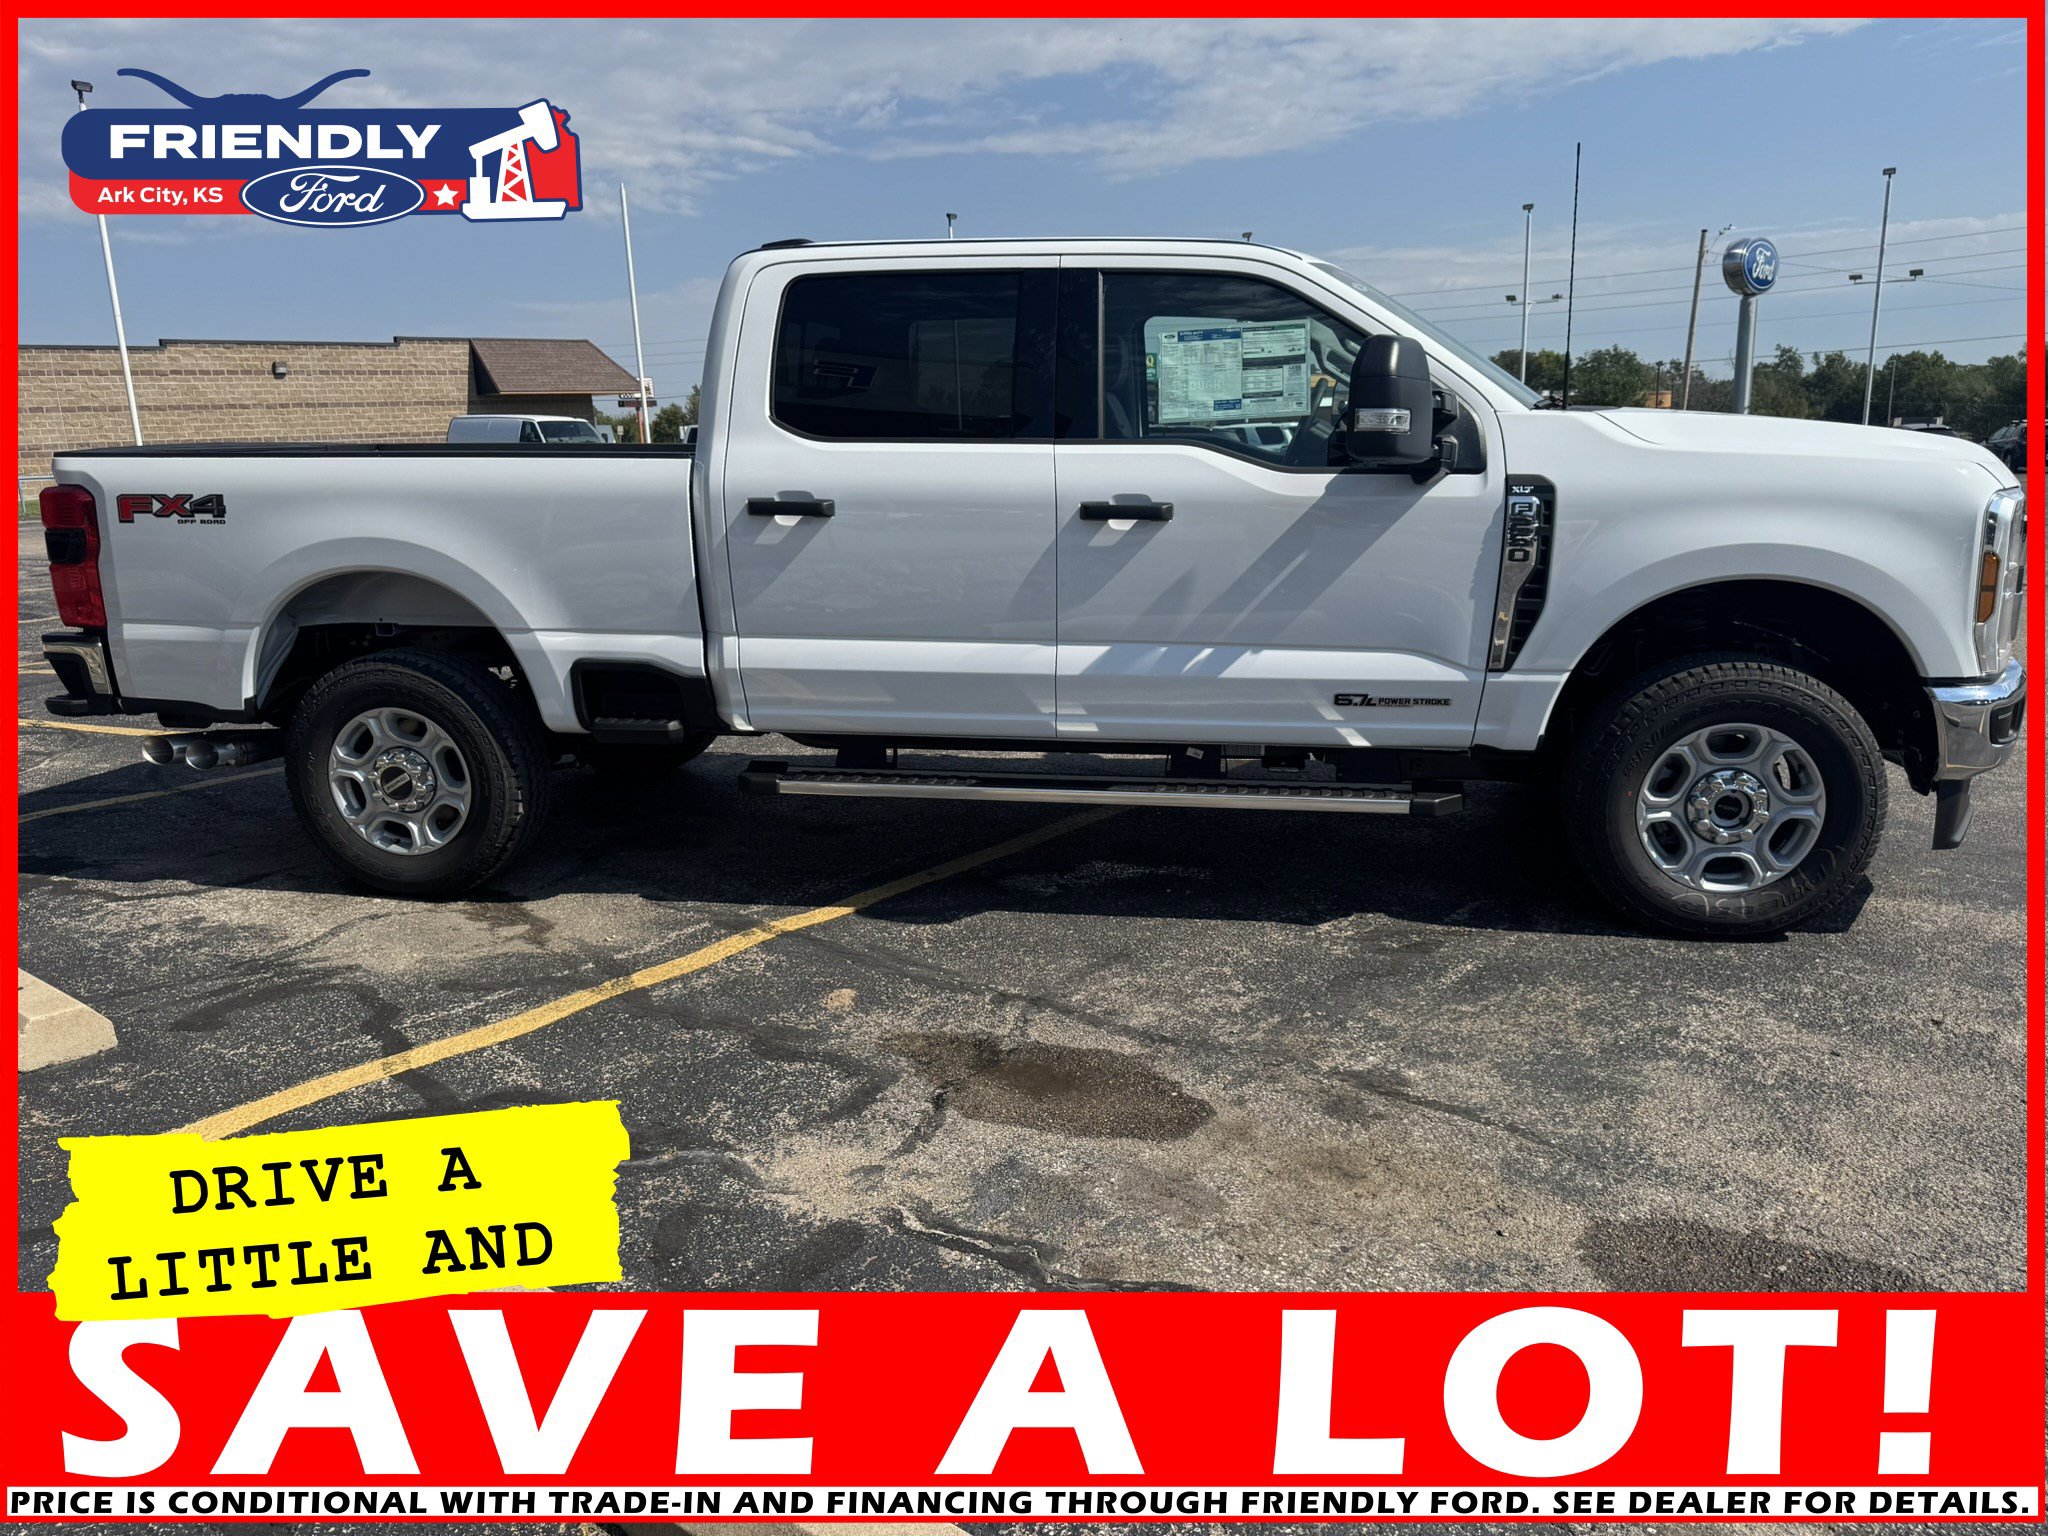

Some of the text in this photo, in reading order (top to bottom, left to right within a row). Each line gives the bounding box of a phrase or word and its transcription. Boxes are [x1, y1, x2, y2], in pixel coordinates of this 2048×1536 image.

[1751, 247, 1776, 282] Ford
[1510, 485, 1534, 494] XLT
[116, 493, 227, 523] FX4
[1333, 693, 1451, 707] 6.7L POWER STROKE
